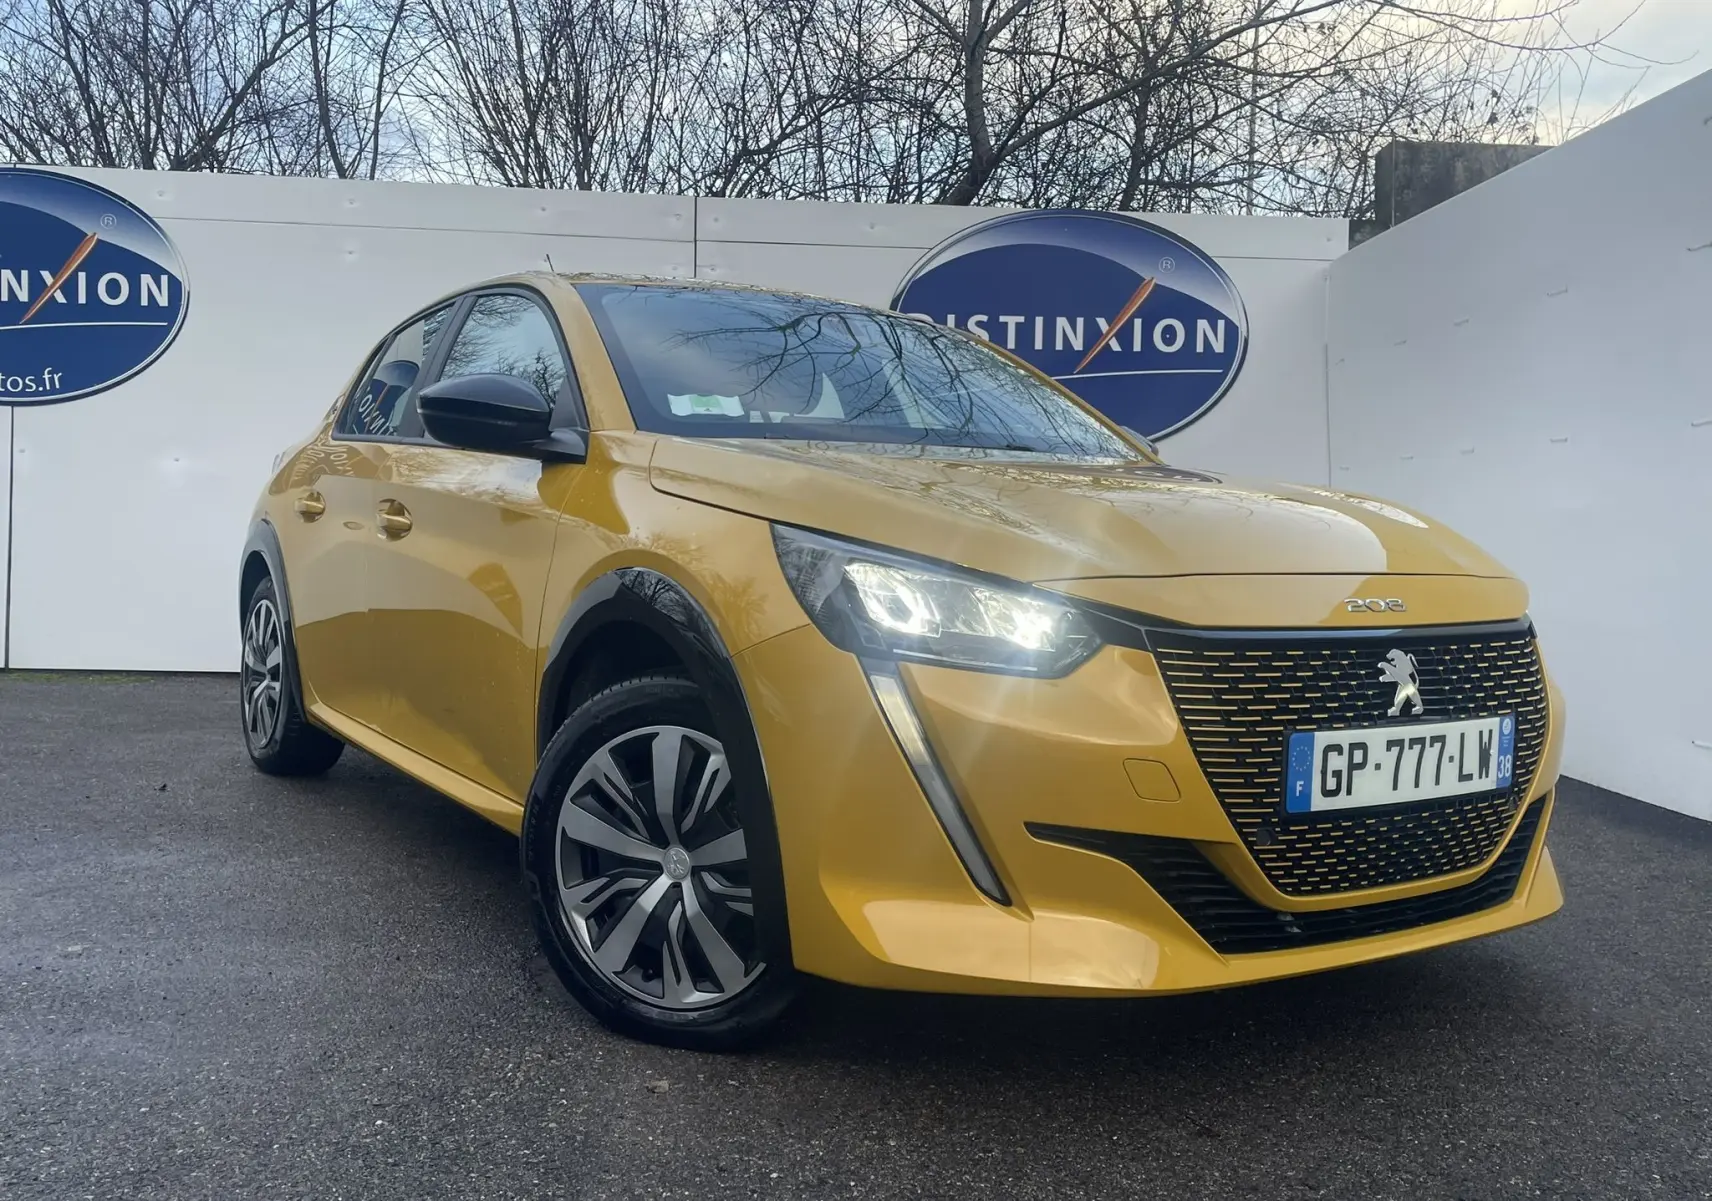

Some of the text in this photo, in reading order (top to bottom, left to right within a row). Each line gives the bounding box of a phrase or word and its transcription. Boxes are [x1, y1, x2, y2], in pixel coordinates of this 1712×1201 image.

[0, 269, 169, 307] NXION
[1343, 598, 1407, 613] 208
[1295, 780, 1305, 798] F
[1320, 729, 1493, 798] GP-777-LW
[1497, 754, 1512, 779] 38
